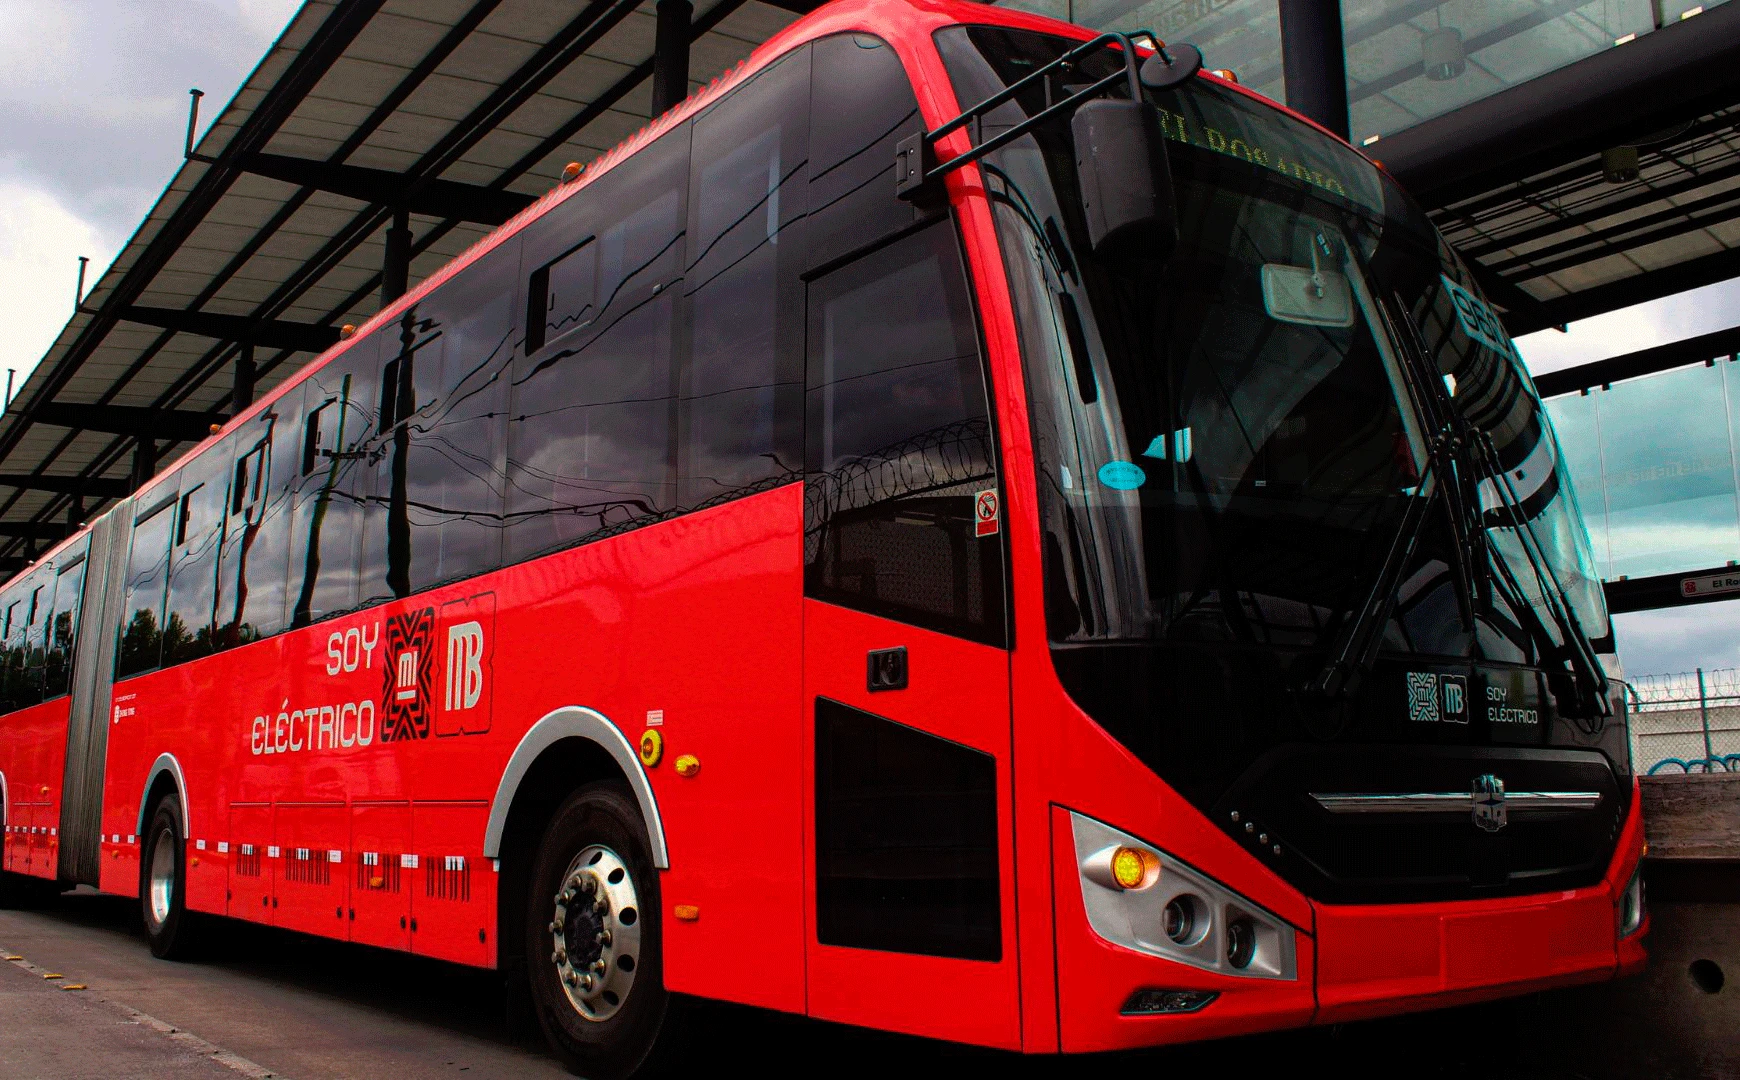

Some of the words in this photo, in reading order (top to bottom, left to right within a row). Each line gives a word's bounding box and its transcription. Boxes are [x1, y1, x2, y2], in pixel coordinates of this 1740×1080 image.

[1725, 578, 1740, 587] Ro
[326, 621, 380, 676] SOY
[445, 620, 483, 712] MB
[1486, 686, 1507, 702] SOY
[251, 697, 375, 755] ELÉCTRICO
[1487, 703, 1538, 724] ELÉCTRICO
